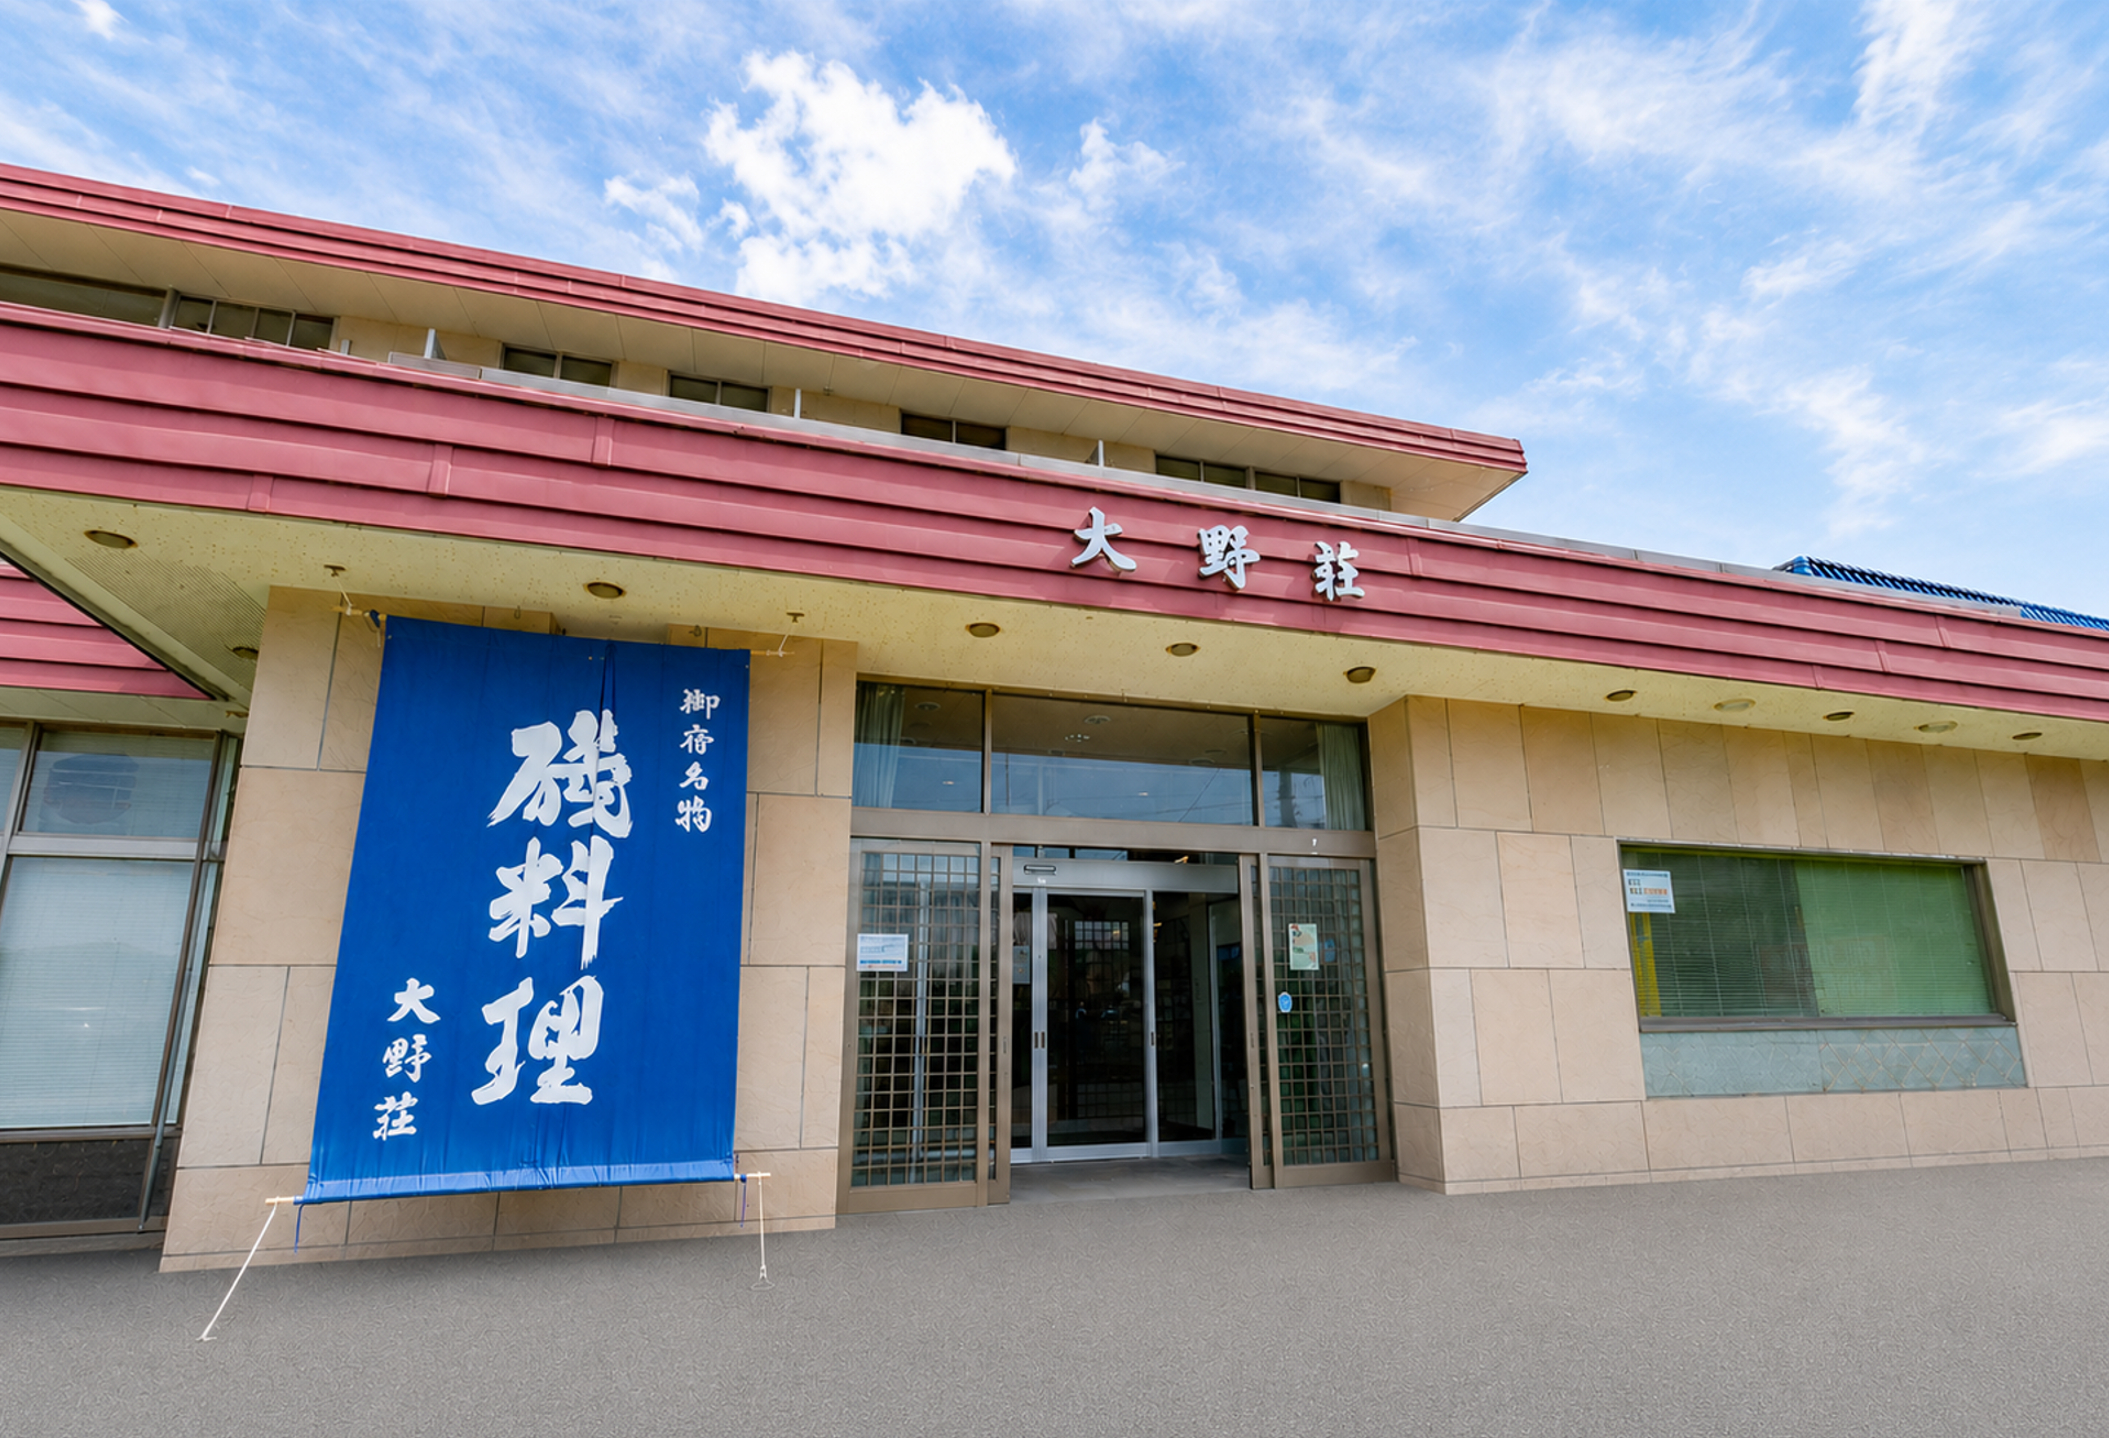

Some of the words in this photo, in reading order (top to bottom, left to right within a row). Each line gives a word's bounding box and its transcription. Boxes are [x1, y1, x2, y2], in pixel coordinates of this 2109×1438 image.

[1070, 506, 1365, 601] 大野荘
[674, 688, 721, 833] 御宿名物
[471, 708, 633, 1106] 磯料理
[372, 977, 441, 1141] 大野荘
